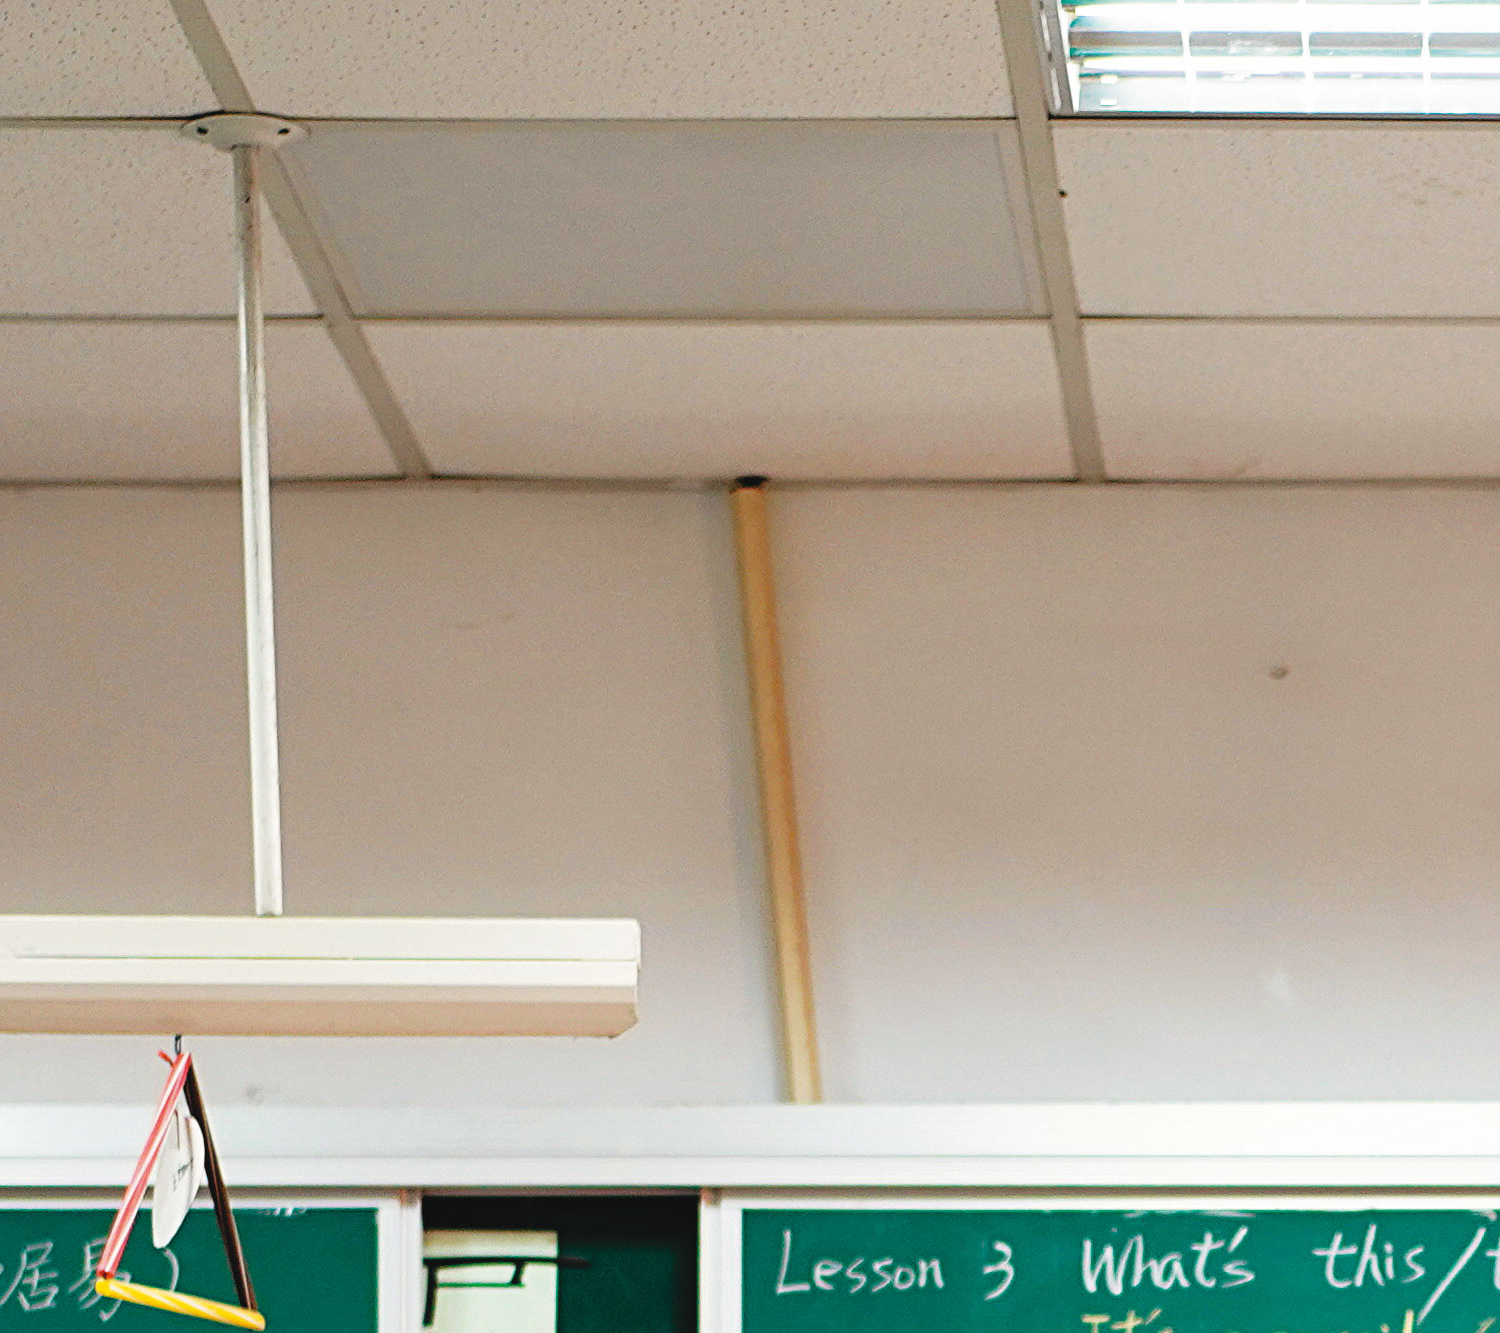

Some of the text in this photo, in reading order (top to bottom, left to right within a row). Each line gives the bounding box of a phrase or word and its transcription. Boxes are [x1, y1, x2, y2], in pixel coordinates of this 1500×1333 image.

[775, 1229, 944, 1295] Lesson
[983, 1240, 1015, 1300] 3
[1081, 1225, 1257, 1296] What's
